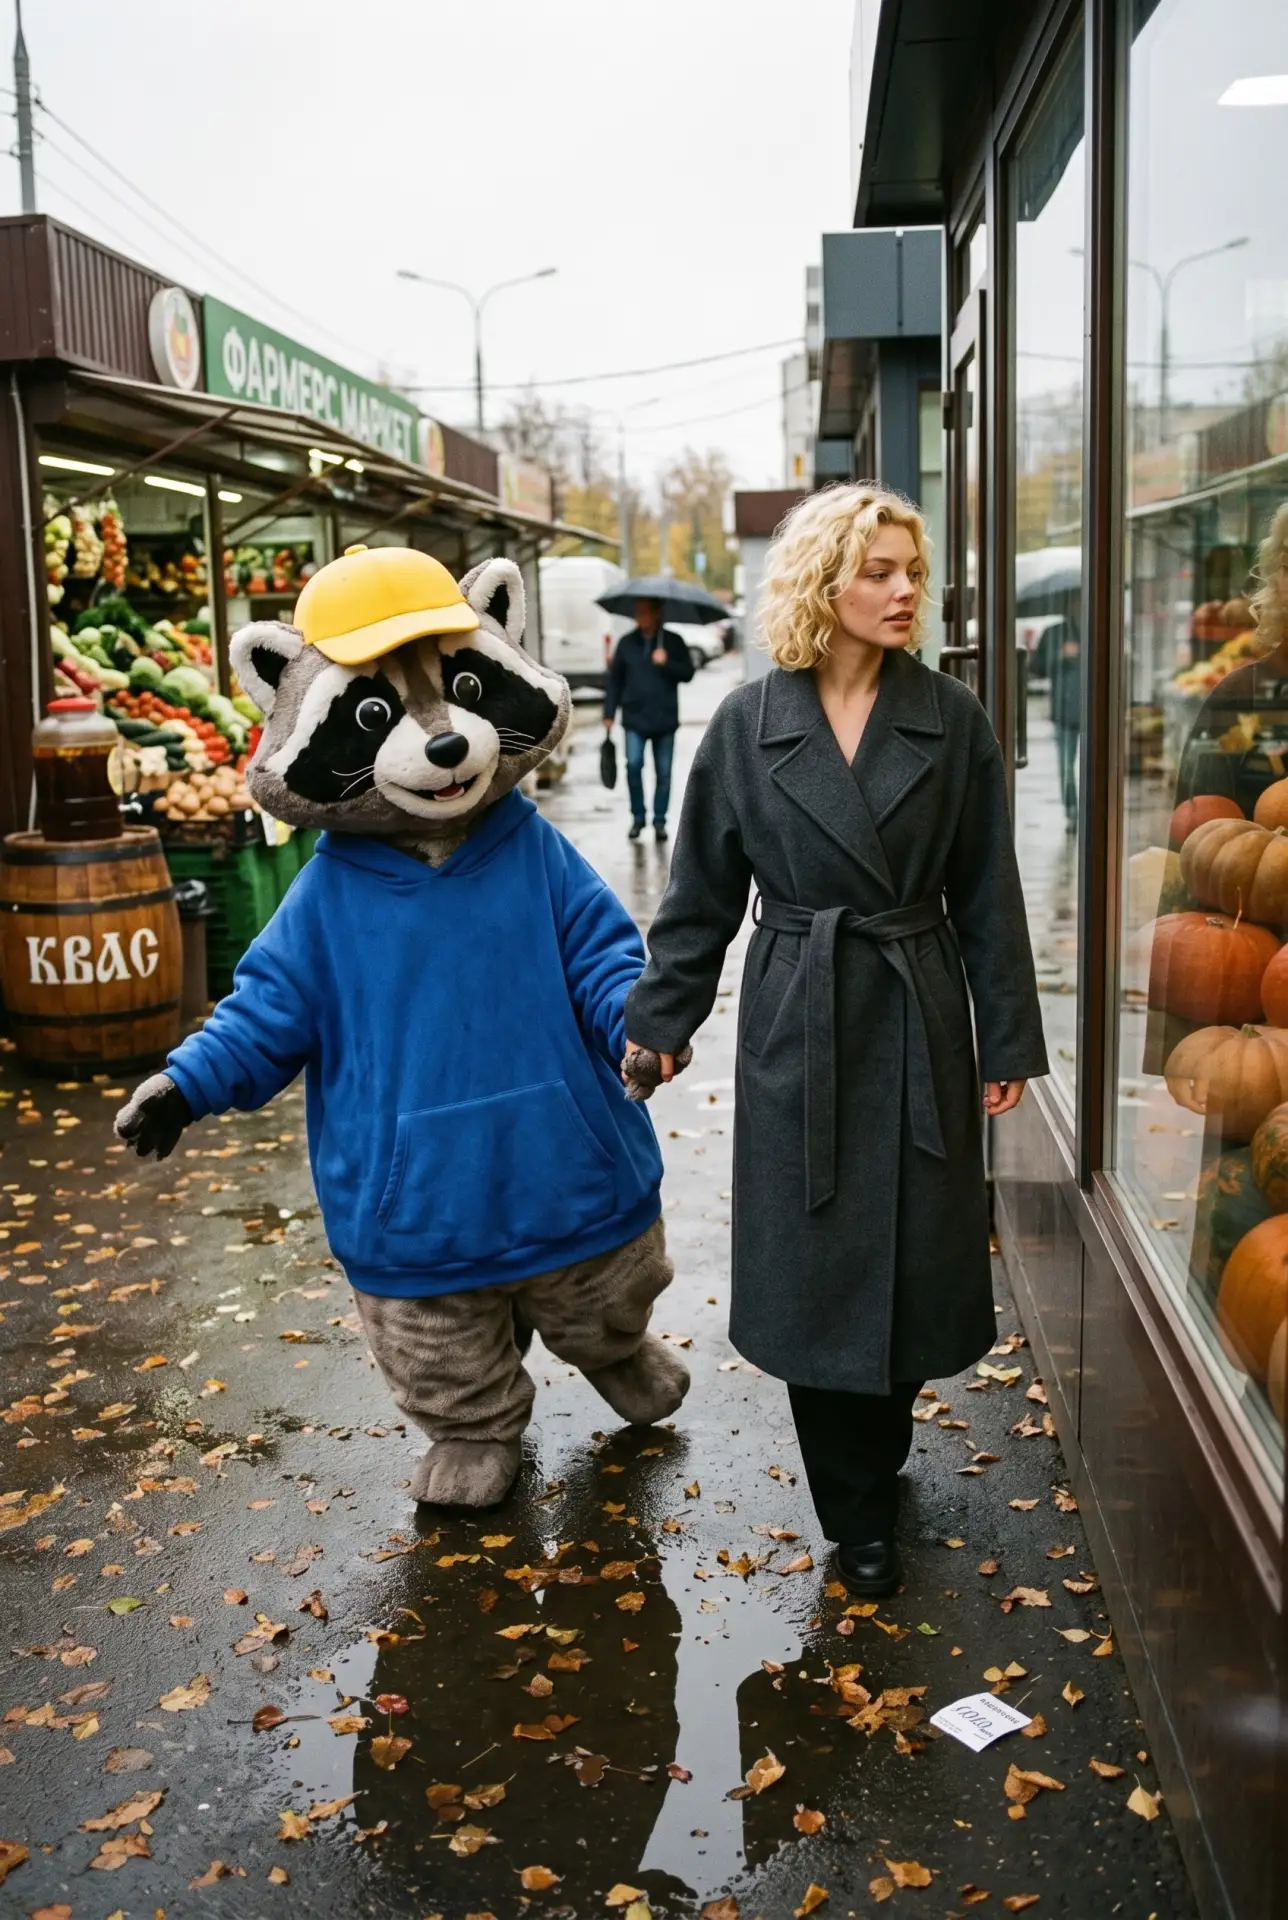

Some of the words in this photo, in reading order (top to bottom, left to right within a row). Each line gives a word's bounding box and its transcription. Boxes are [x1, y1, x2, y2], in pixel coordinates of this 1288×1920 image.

[222, 326, 339, 422] ФАРМЕРС
[340, 382, 412, 462] МАРКЕТ
[26, 927, 159, 985] КВАС
